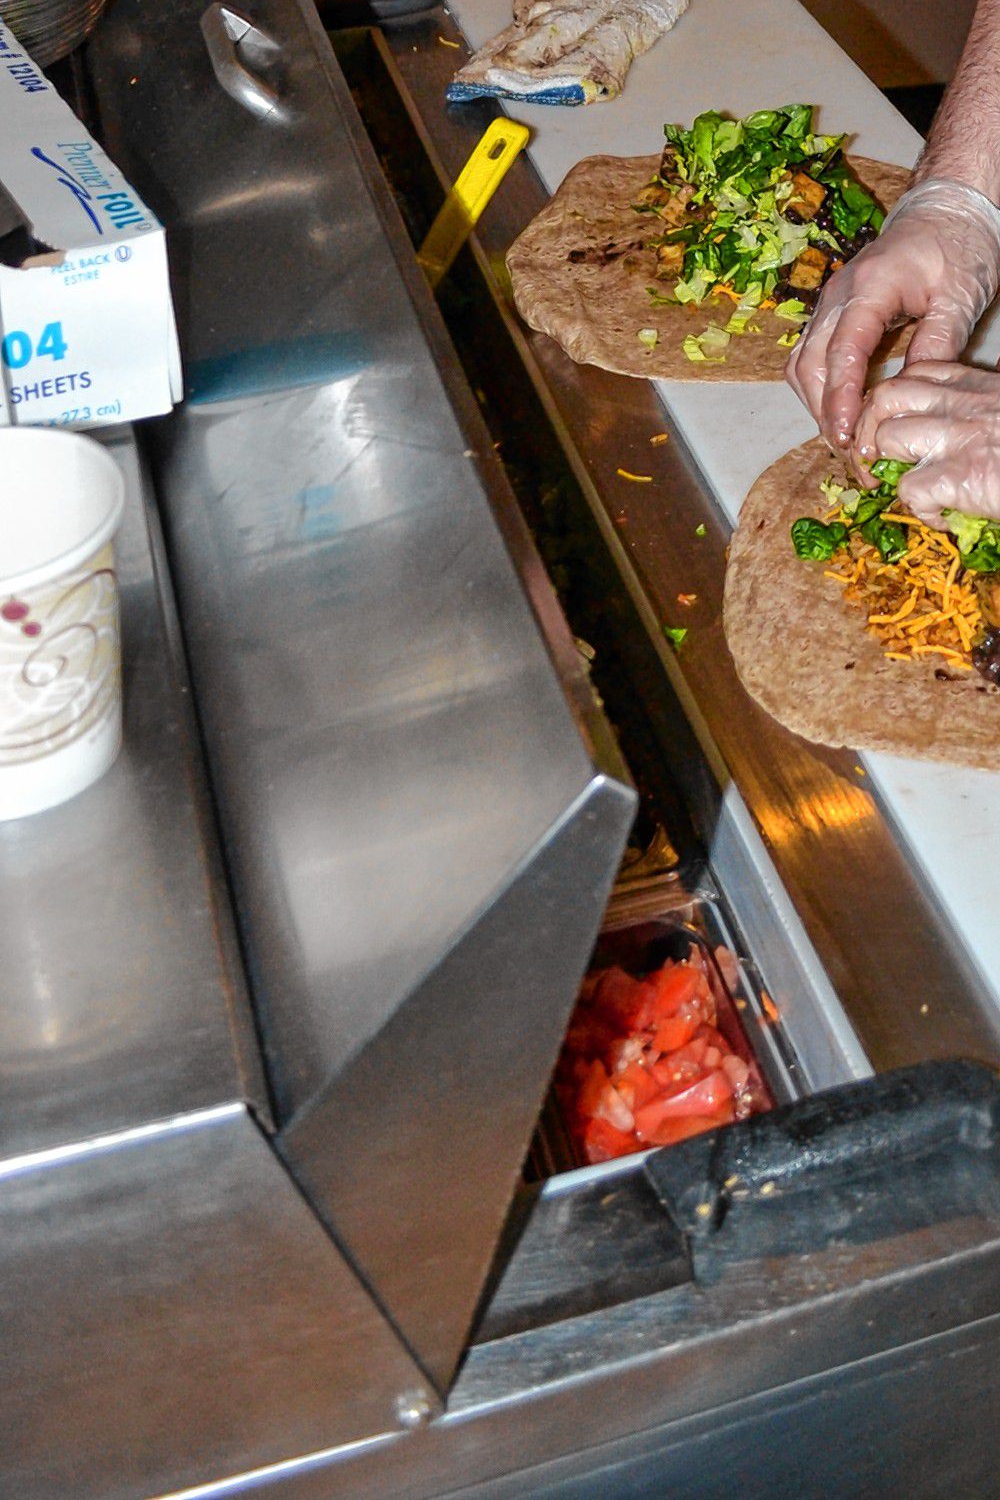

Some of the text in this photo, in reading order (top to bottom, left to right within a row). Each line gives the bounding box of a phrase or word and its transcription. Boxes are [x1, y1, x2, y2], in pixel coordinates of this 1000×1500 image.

[6, 63, 48, 93] 12104
[57, 142, 145, 230] Premier FOIL
[80, 253, 110, 269] BACK
[10, 371, 92, 404] SHEETS
[61, 407, 91, 425] 27.3
